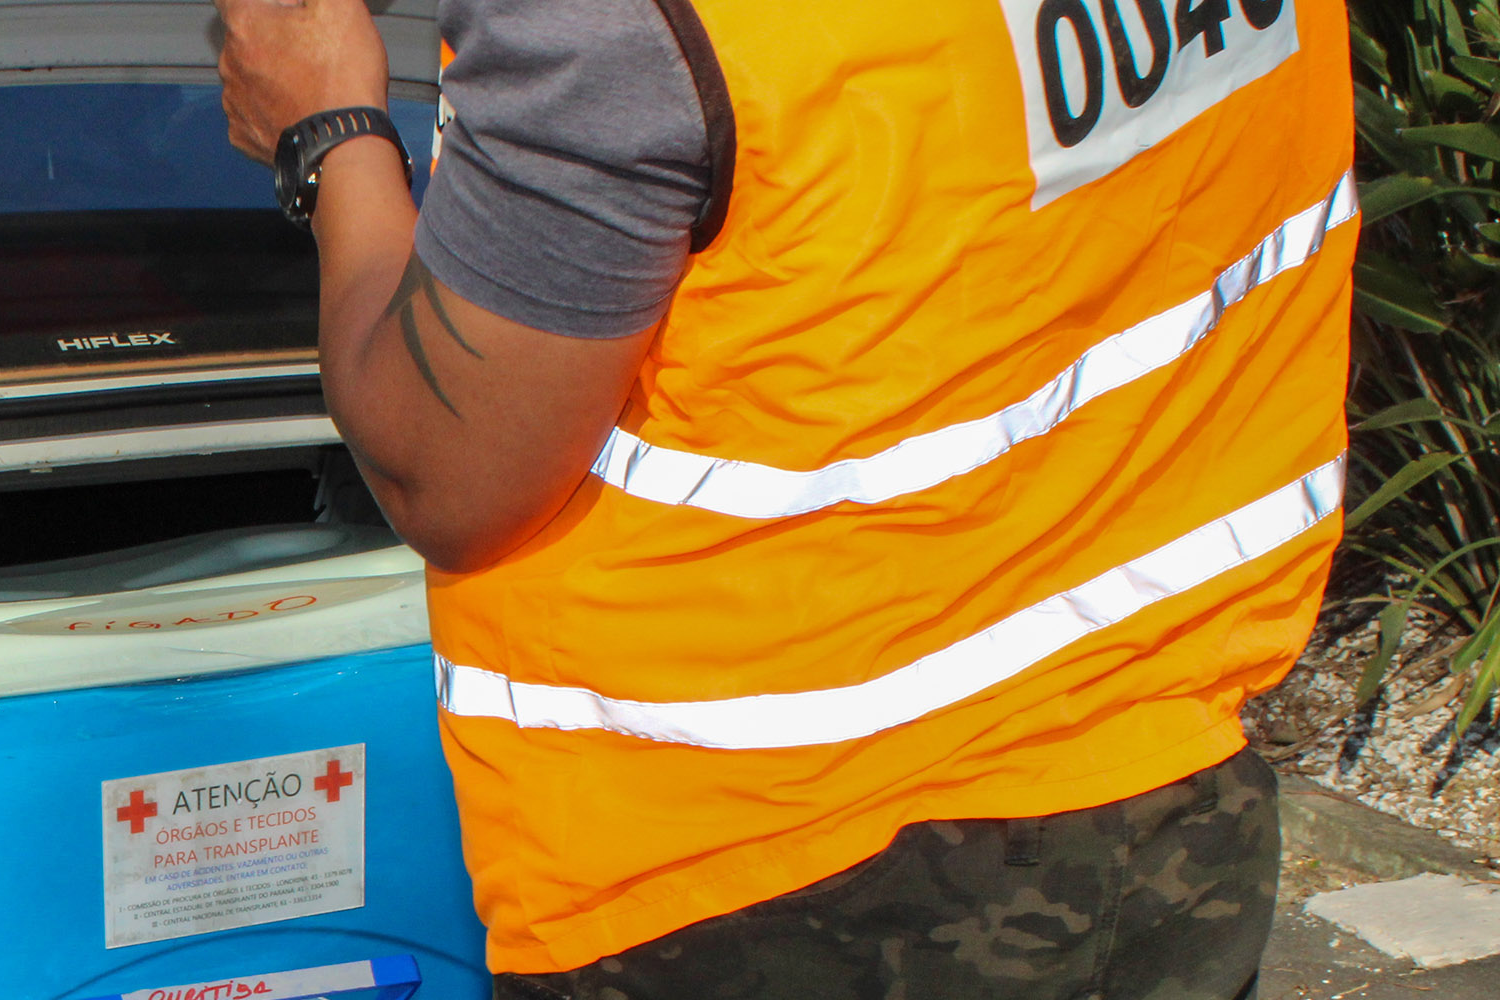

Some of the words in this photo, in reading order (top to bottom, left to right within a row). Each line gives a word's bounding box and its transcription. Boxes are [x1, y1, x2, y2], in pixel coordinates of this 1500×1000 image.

[1036, 0, 1283, 148] 00
[172, 771, 302, 815] ATENÇÃO
[156, 820, 228, 845] ÓRGÃOS
[234, 818, 242, 833] E
[247, 806, 317, 829] TECIDOS
[145, 875, 156, 885] EM
[159, 871, 179, 882] CASO
[181, 869, 191, 878] DE
[237, 854, 284, 869] VAZAMENTO
[285, 852, 298, 861] OU
[299, 846, 329, 859] OUTRAS
[154, 849, 198, 868] PARA
[203, 829, 319, 861] TRANSPLANTE
[226, 869, 256, 882] ENTRAR
[257, 867, 269, 876] EM
